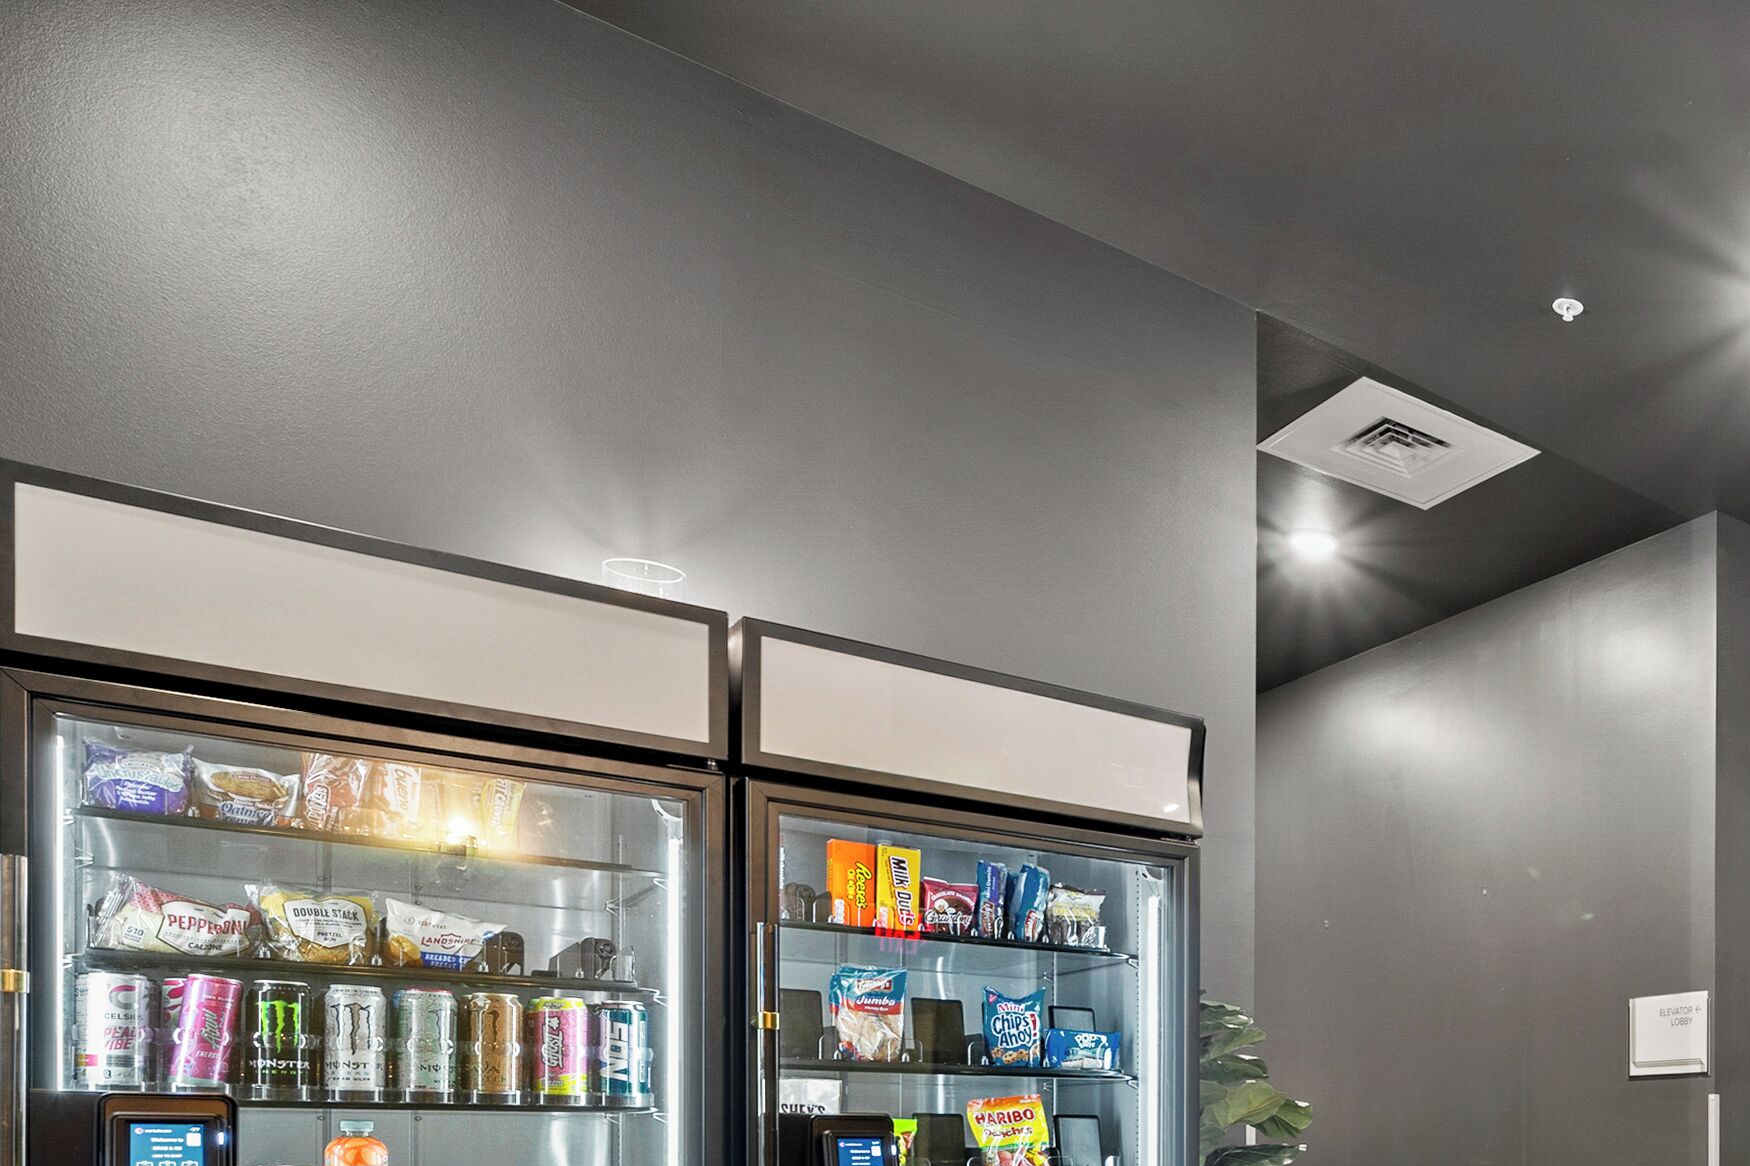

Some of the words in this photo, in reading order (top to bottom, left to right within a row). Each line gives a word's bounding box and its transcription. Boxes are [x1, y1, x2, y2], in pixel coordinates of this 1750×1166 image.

[889, 855, 911, 889] MILK
[856, 862, 872, 909] Reese's
[293, 907, 330, 918] DOUBLE
[332, 908, 359, 921] STACK
[168, 914, 247, 935] PEPPERONI
[127, 926, 144, 936] 510
[420, 936, 477, 947] LANDSHIRE
[856, 996, 896, 1006] Jumbo
[997, 1002, 1025, 1014] Mini
[1659, 1006, 1693, 1017] ELEVATOR
[992, 1014, 1030, 1034] Chips
[1671, 1017, 1693, 1026] LOBBY
[601, 1022, 628, 1081] NOS
[249, 1059, 310, 1070] MONSTER
[325, 1061, 383, 1071] MONSTR
[975, 1109, 1035, 1125] HARIBO
